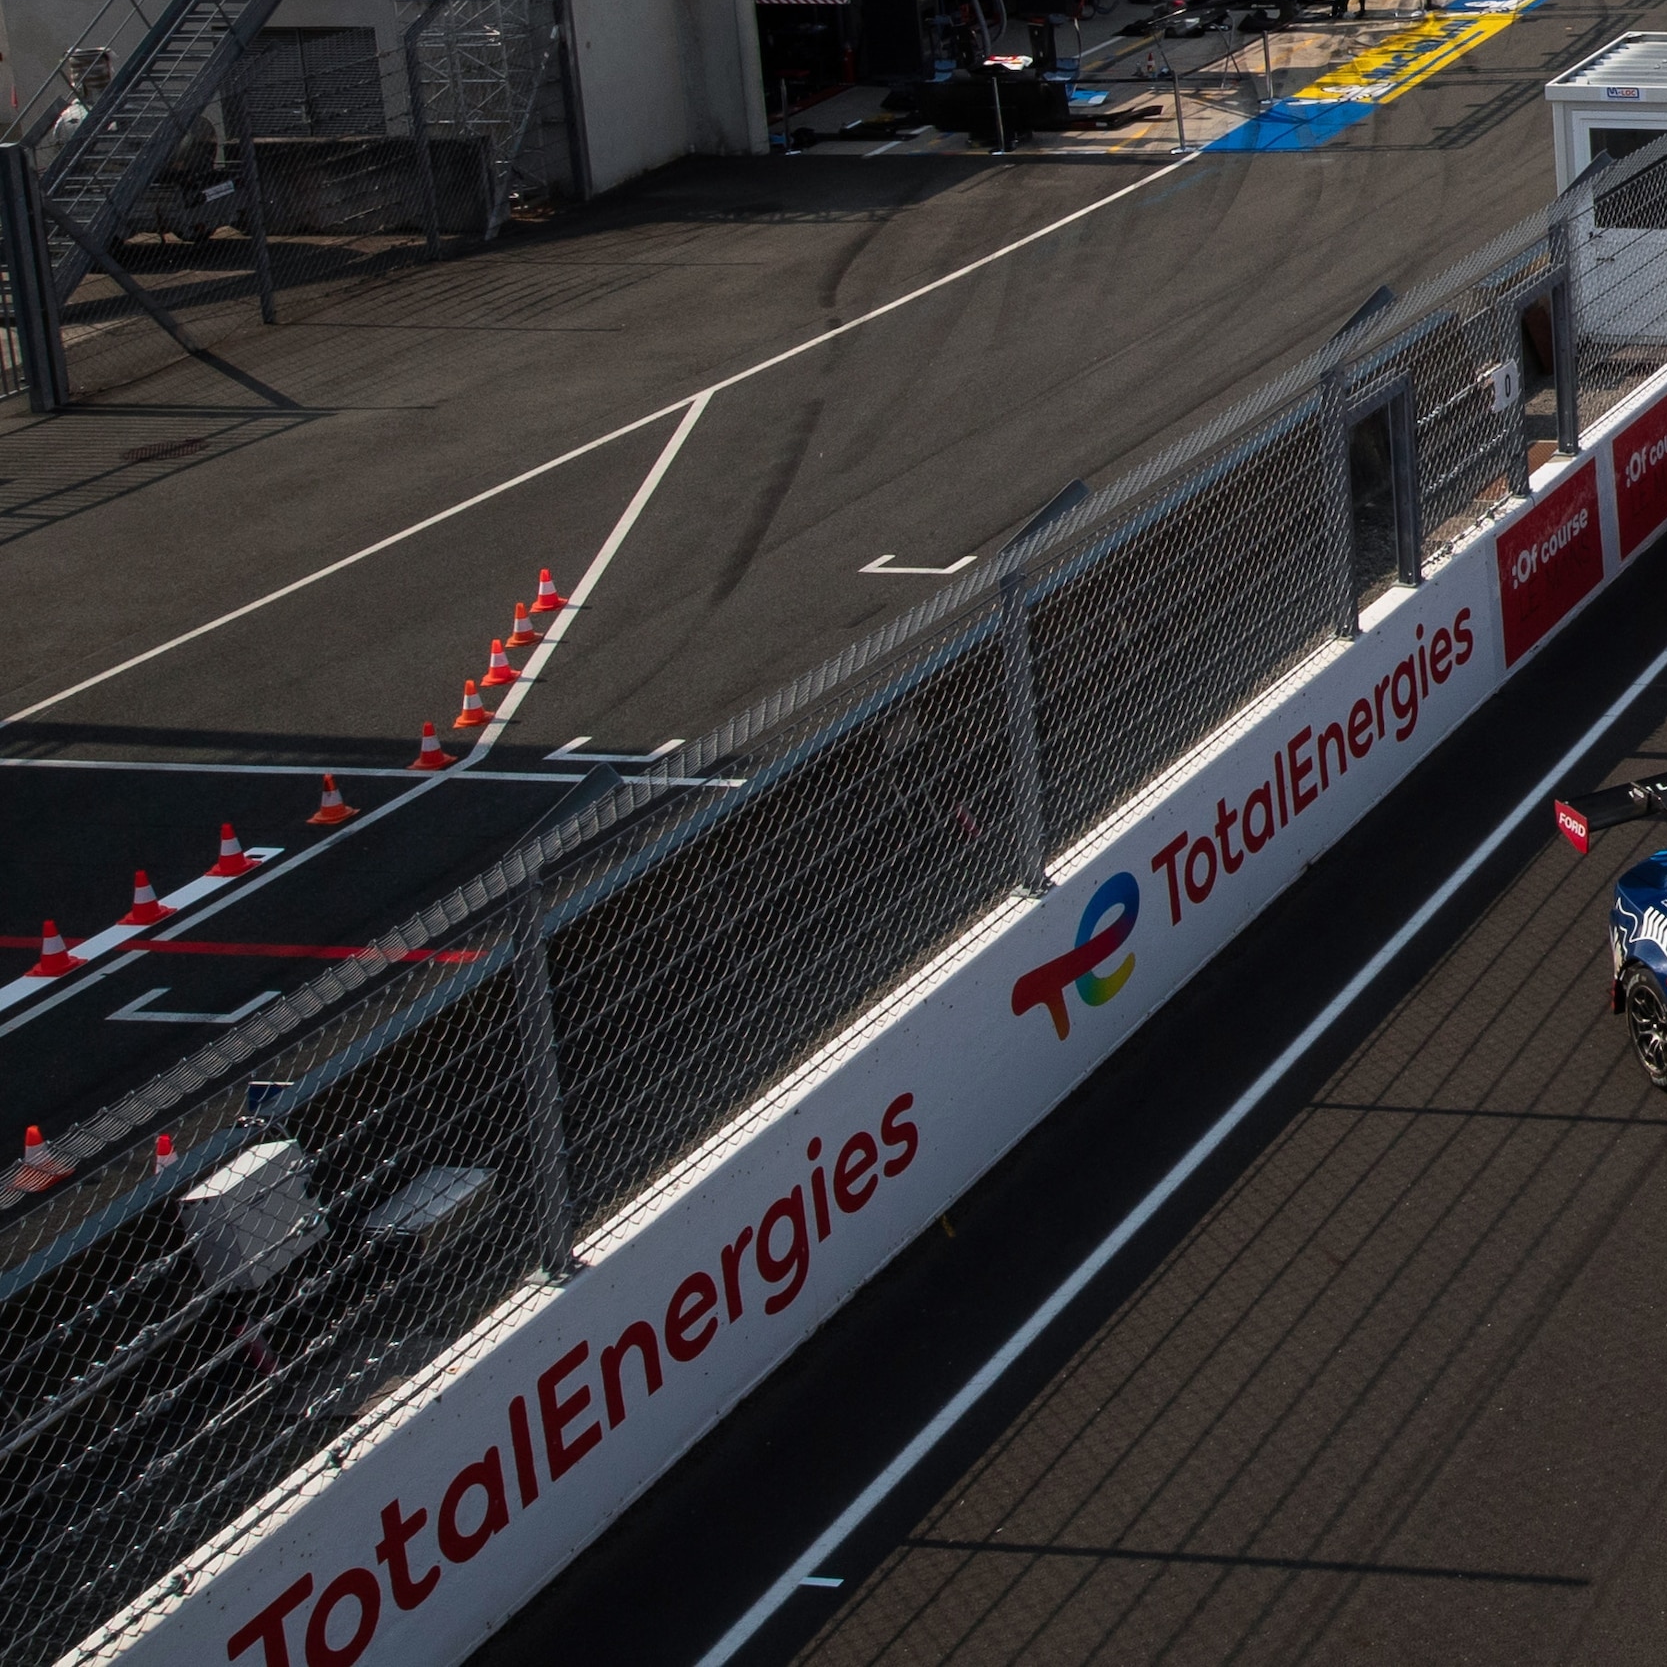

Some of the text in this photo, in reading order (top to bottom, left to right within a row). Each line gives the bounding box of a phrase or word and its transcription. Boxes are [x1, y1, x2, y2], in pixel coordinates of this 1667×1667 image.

[1540, 507, 1588, 566] course
[1150, 607, 1475, 925] TotalEnergies
[1558, 811, 1587, 839] FORD
[226, 1091, 919, 1667] TotalEnergies
